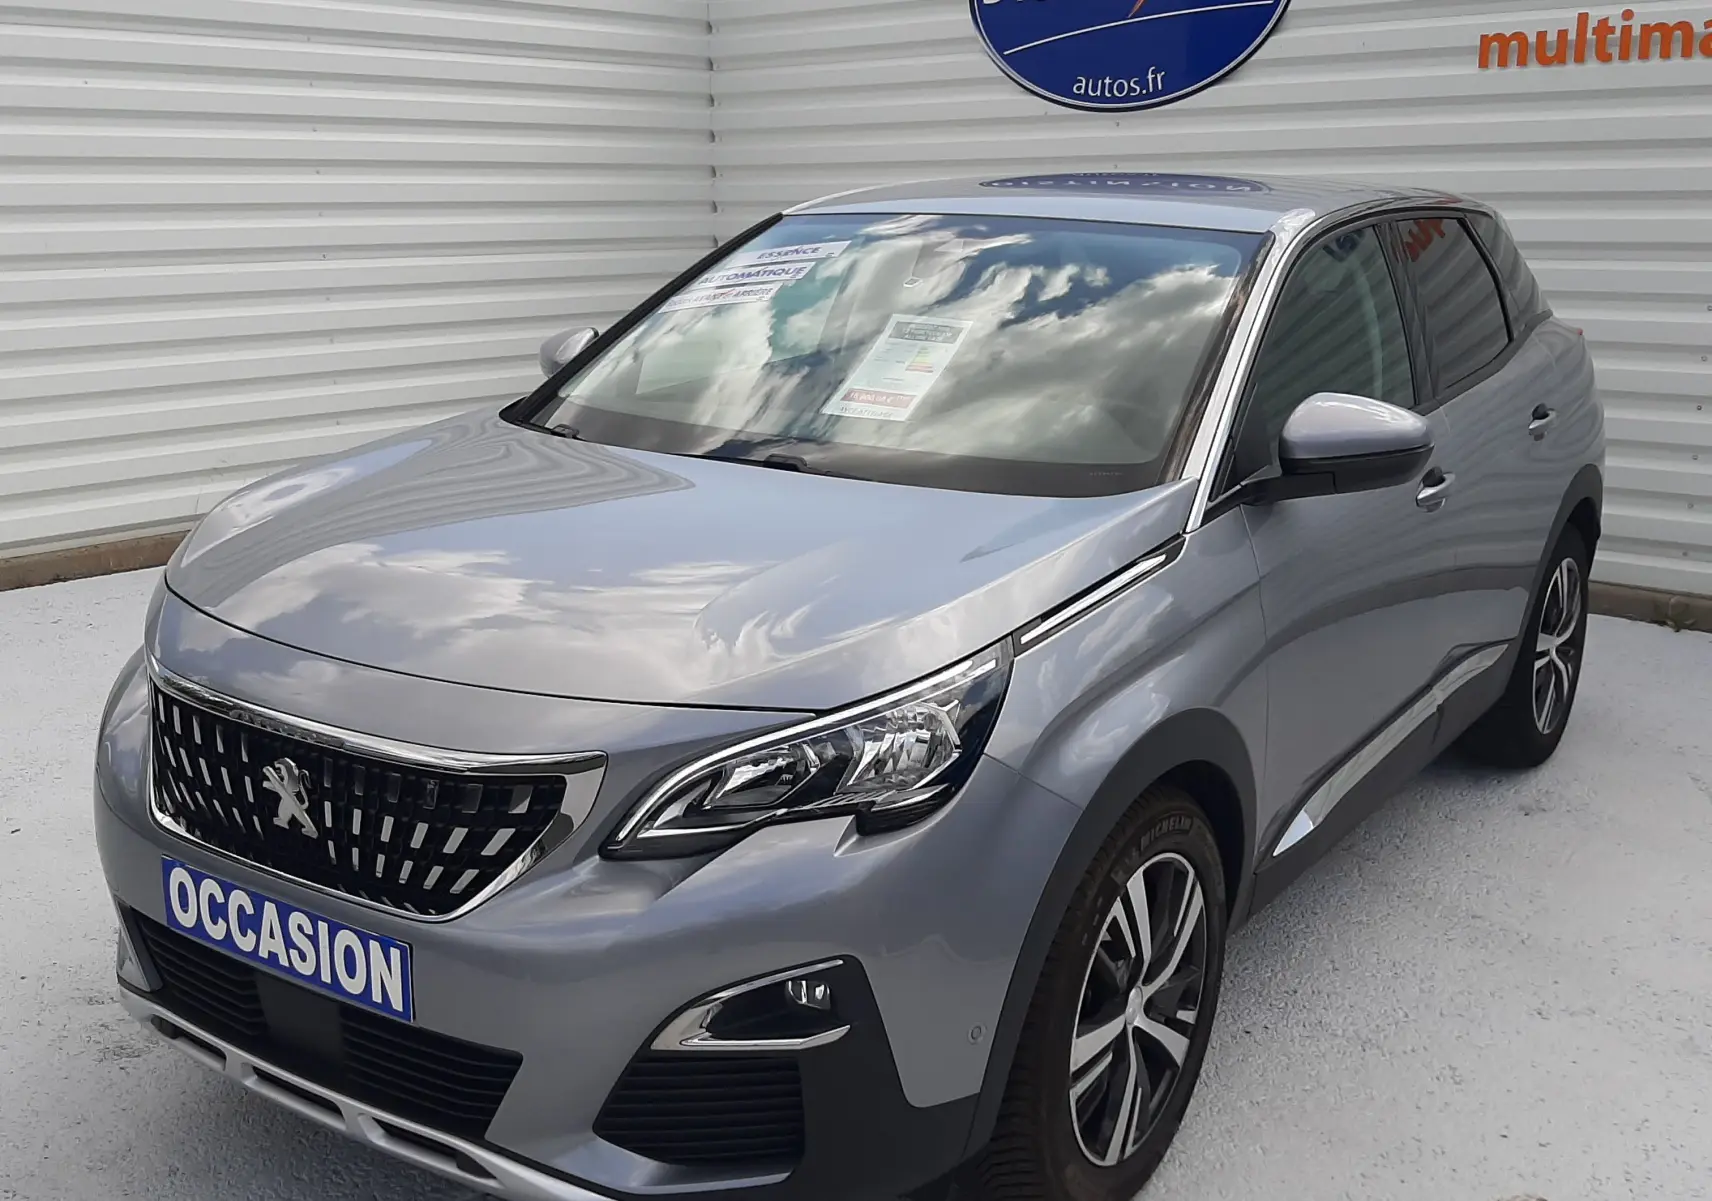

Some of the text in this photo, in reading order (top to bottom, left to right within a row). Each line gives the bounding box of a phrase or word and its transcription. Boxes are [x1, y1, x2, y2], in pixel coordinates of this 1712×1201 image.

[1073, 66, 1166, 97] autos.fr
[756, 246, 821, 260] ESSENCE
[699, 266, 807, 284] AUTOMATIQUE
[1140, 815, 1193, 851] MICHELIN
[169, 867, 404, 1012] OCCASION
